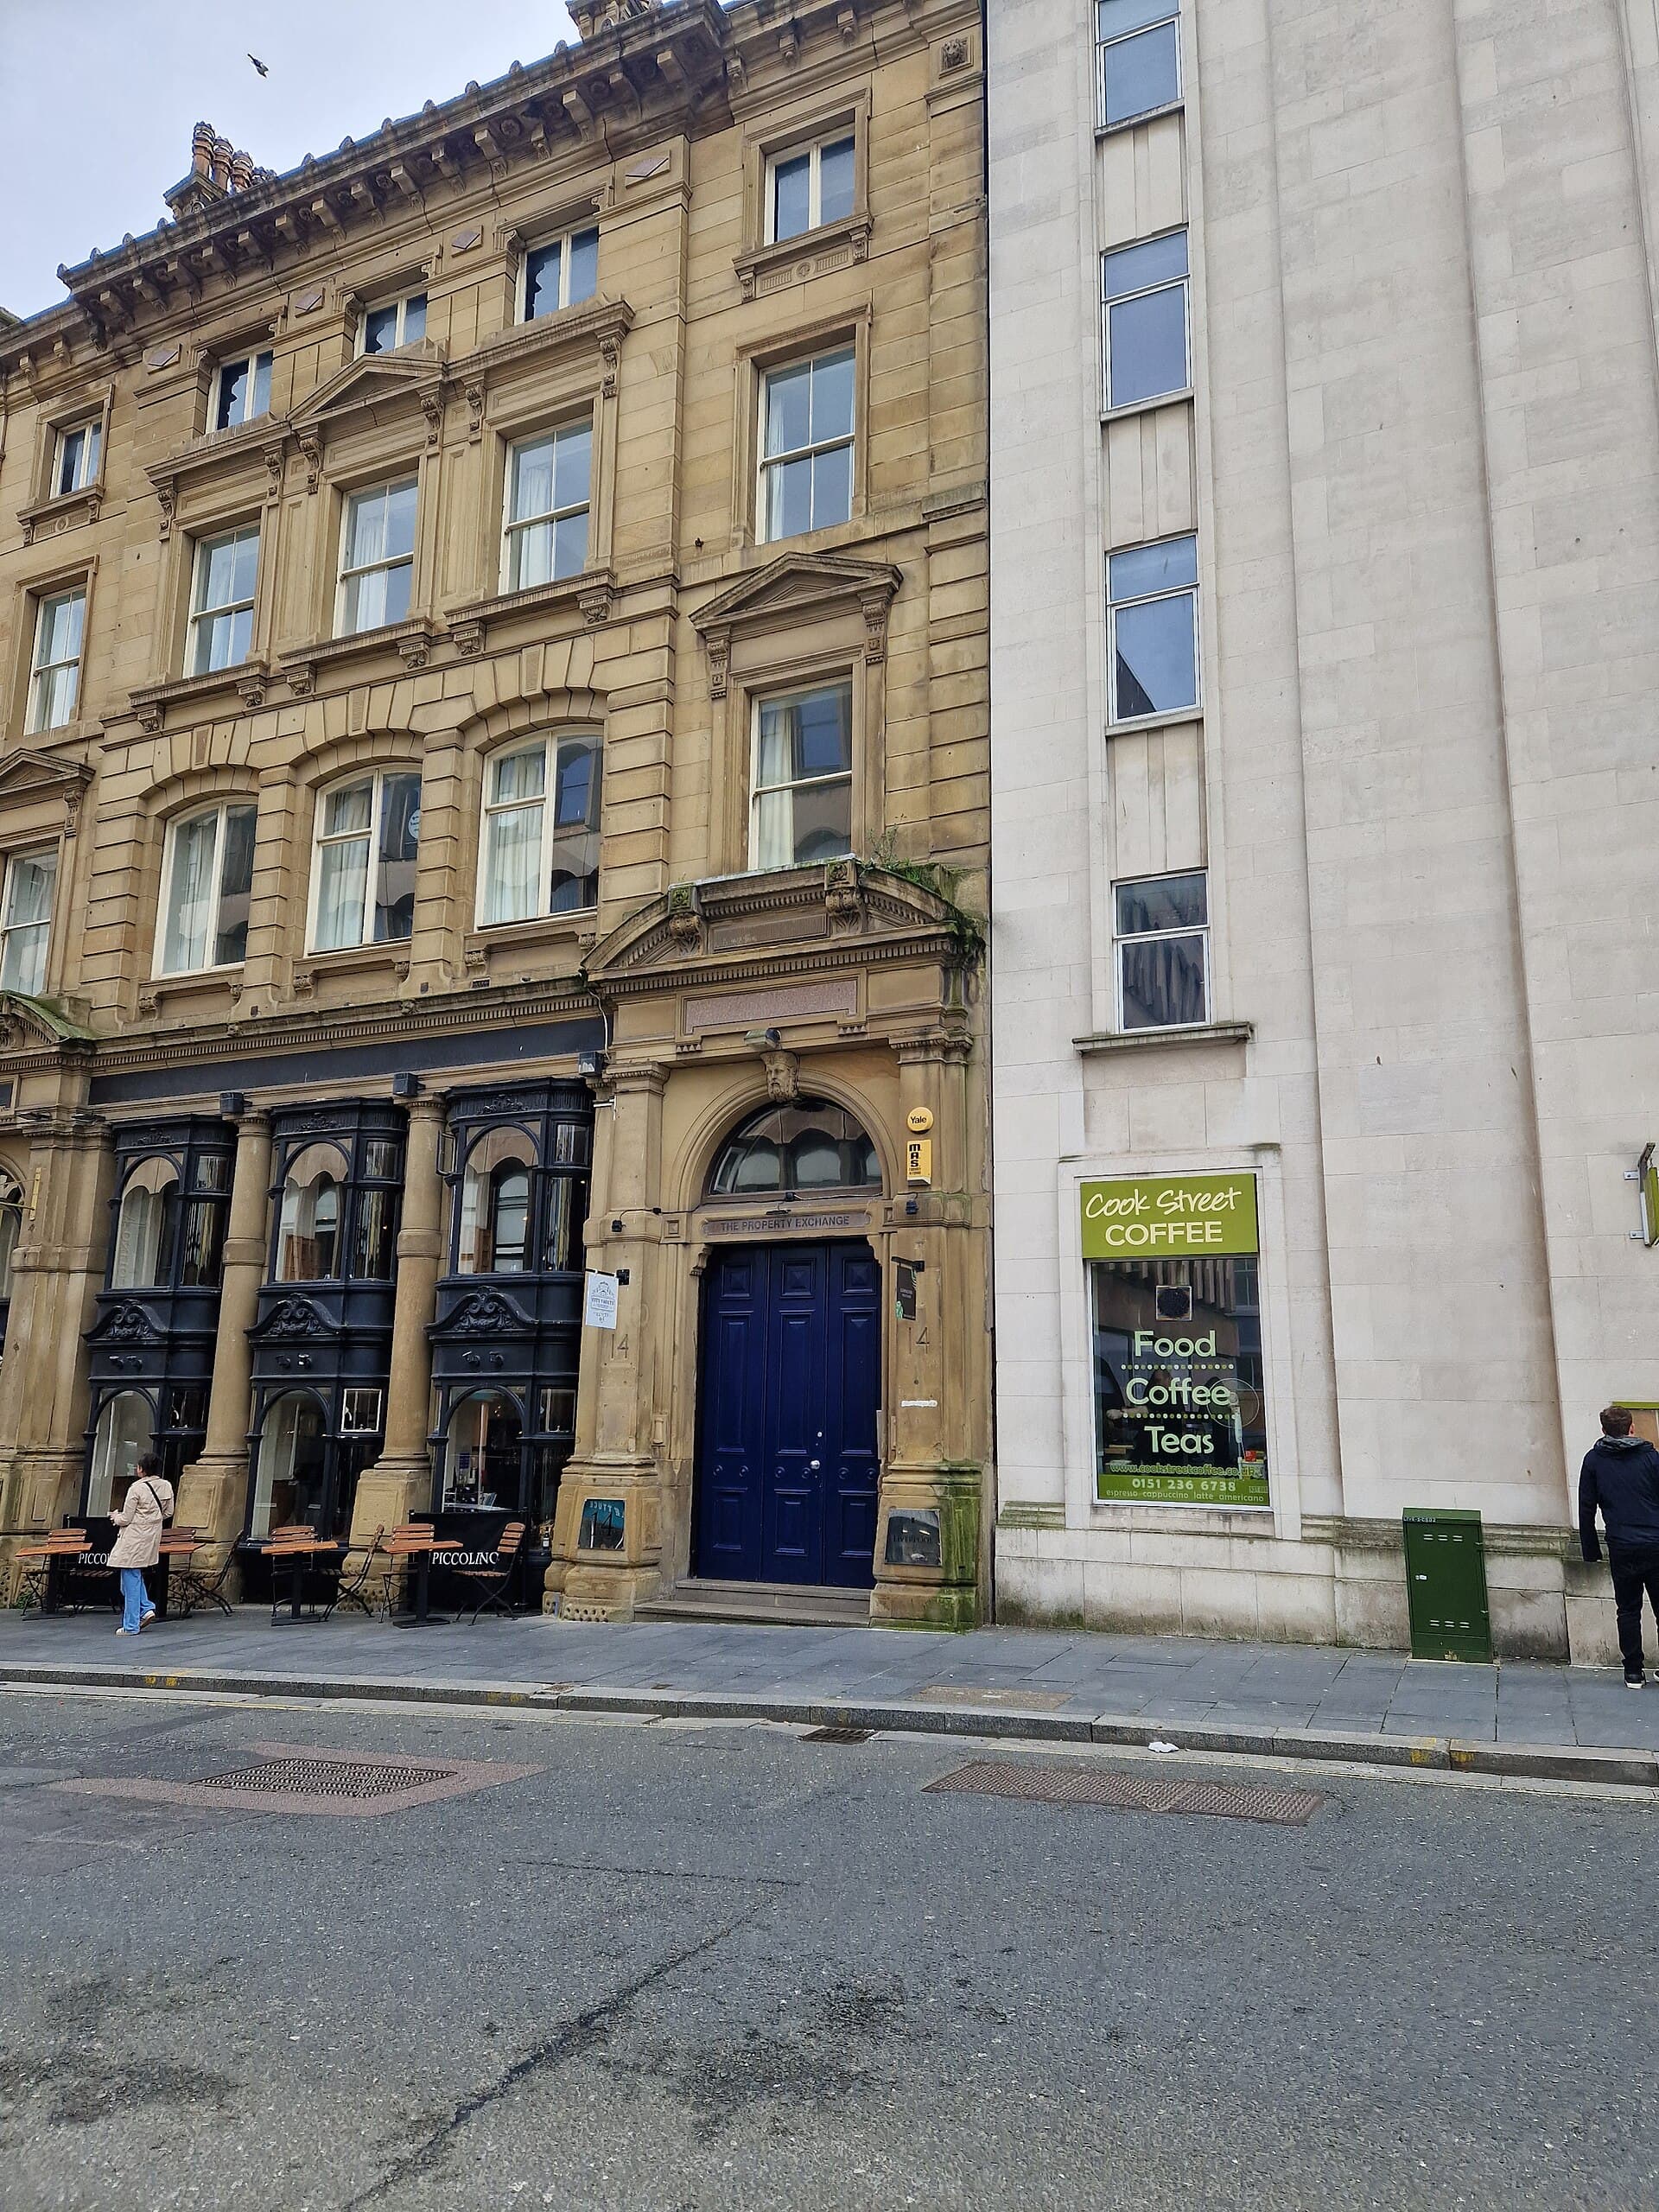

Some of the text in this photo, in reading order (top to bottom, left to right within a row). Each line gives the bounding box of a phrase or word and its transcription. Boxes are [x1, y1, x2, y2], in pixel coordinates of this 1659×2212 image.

[910, 1116, 927, 1124] Yale
[1085, 1186, 1242, 1218] Cook Street
[720, 1216, 850, 1232] THE PROPERTY EXCHANGE
[1105, 1220, 1224, 1246] COFFEE
[610, 1333, 629, 1359] 14
[908, 1326, 930, 1355] 14
[1134, 1330, 1217, 1357] Food
[1126, 1376, 1231, 1406] Coffee
[1143, 1425, 1215, 1454] Teas
[1132, 1478, 1161, 1489] 0151
[1167, 1478, 1193, 1491] 236
[1200, 1480, 1236, 1492] 6738
[1142, 1491, 1189, 1500] cappuccino
[1193, 1491, 1214, 1500] latte
[1218, 1493, 1264, 1503] americano
[590, 1511, 614, 1536] 14
[78, 1553, 111, 1565] PICCO
[432, 1551, 499, 1565] PICCOLINO
